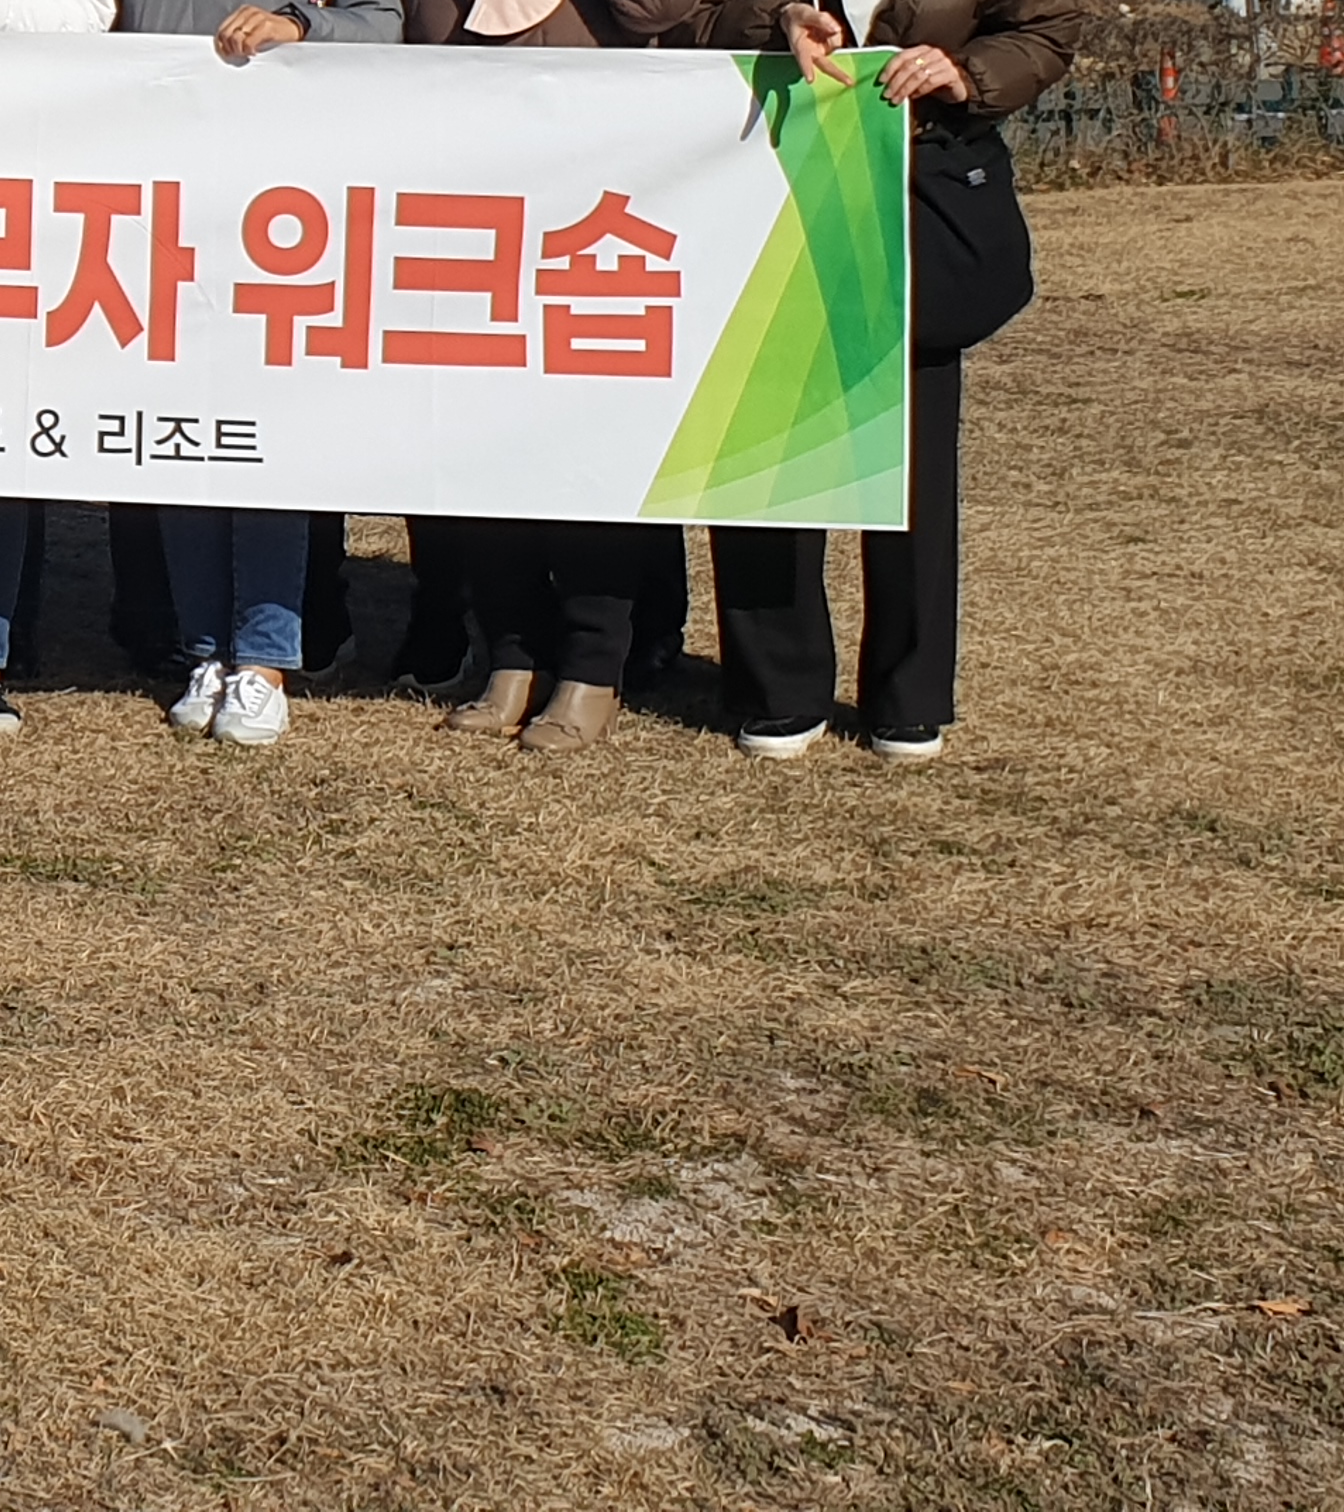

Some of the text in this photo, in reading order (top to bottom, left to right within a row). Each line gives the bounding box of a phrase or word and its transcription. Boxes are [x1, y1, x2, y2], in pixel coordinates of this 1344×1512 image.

[232, 186, 682, 379] 워크숍
[30, 408, 69, 459] &
[97, 410, 265, 467] 리조트
